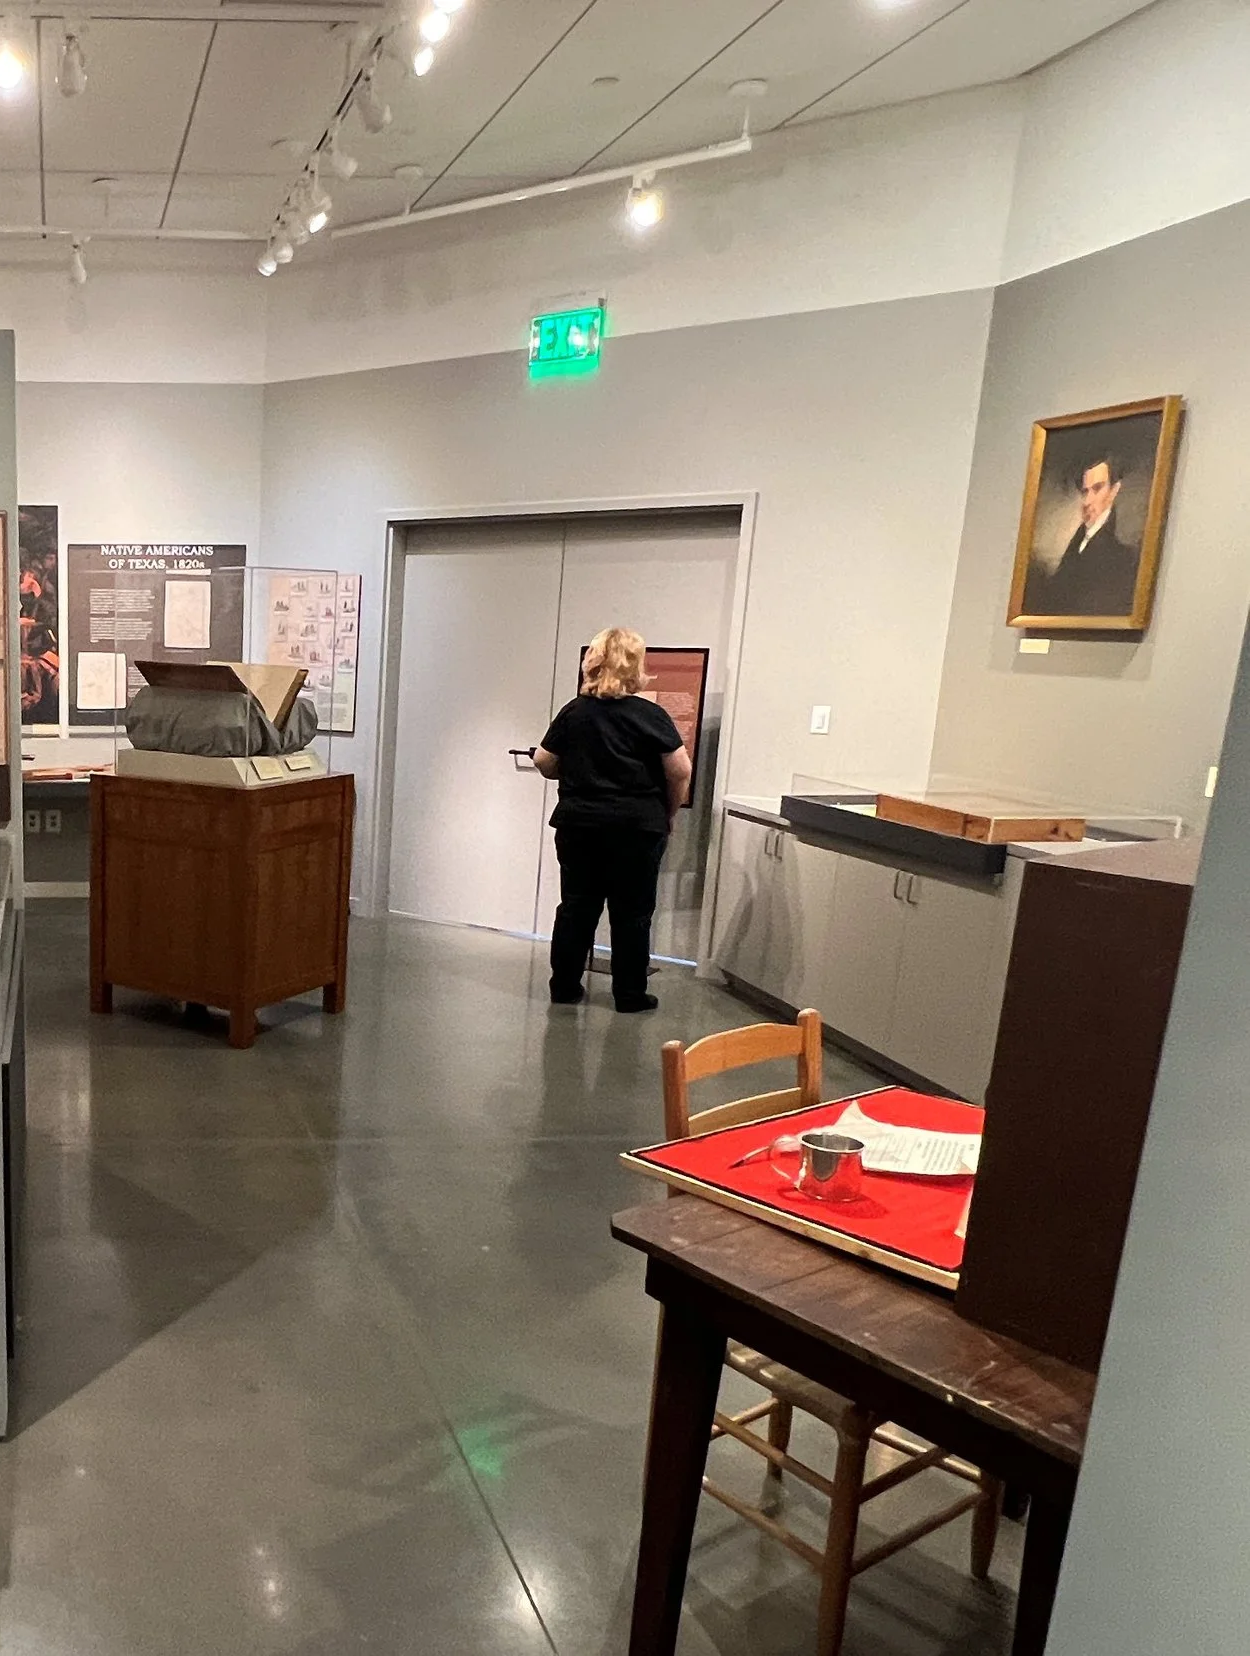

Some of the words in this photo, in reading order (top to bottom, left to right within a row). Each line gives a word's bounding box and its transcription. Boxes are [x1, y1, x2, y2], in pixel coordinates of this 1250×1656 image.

[100, 545, 143, 556] NATIVE
[145, 545, 214, 556] AMERICANS
[108, 559, 125, 569] OF
